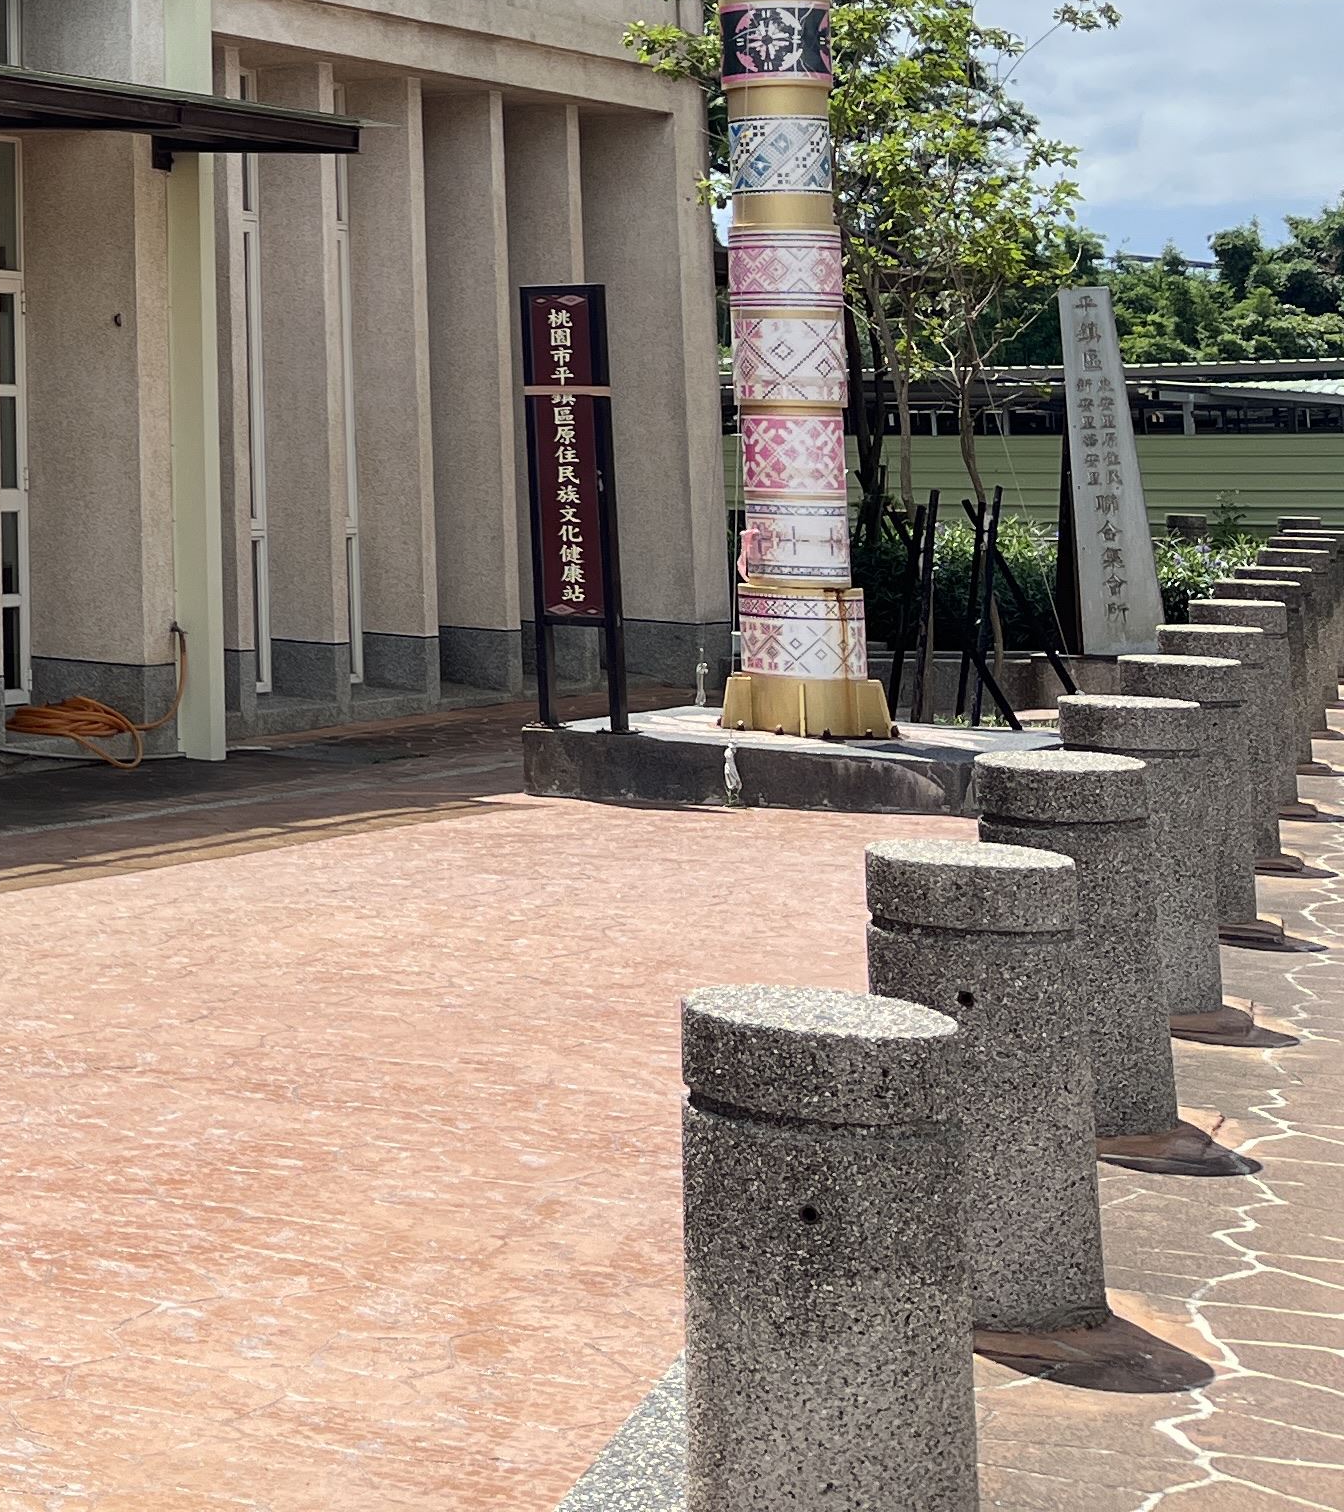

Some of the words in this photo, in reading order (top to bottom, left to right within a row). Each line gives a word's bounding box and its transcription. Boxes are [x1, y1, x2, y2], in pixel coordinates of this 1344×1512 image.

[1075, 295, 1103, 372] 平鎮區
[1094, 493, 1130, 625] 聯合集會所
